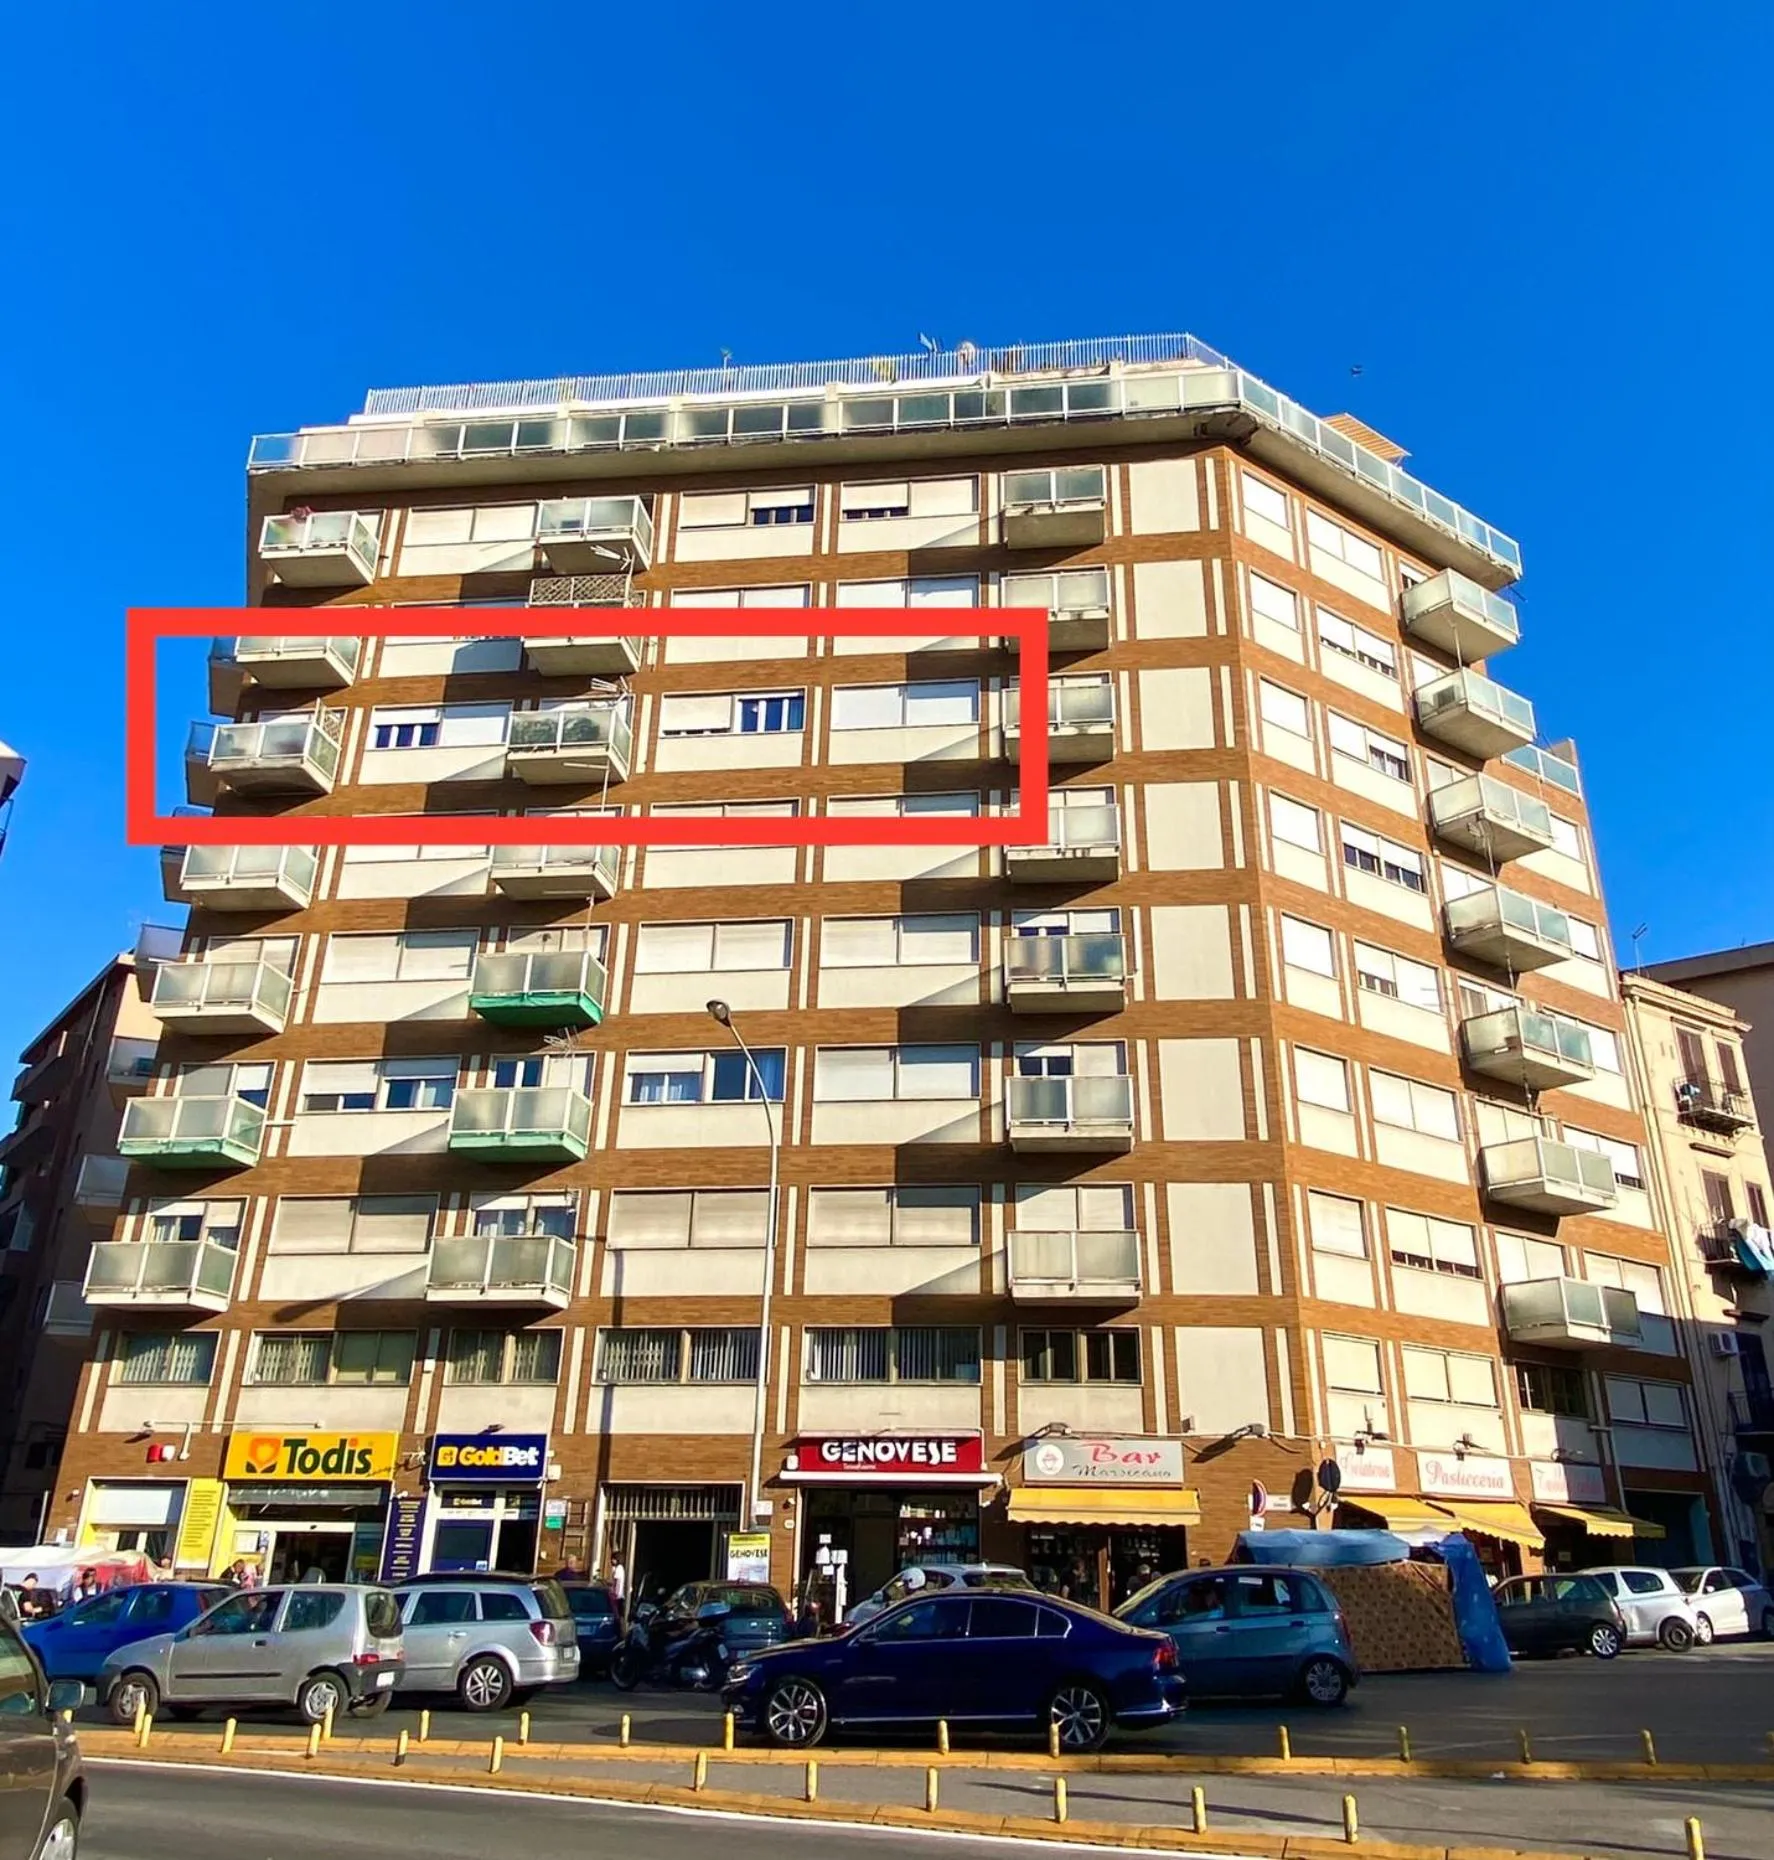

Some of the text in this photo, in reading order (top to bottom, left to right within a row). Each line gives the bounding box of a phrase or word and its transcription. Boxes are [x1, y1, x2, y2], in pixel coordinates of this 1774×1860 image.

[283, 1438, 372, 1475] Todis
[459, 1446, 540, 1466] GoldBet
[821, 1441, 957, 1465] GENOVESE
[1080, 1442, 1161, 1464] Bar
